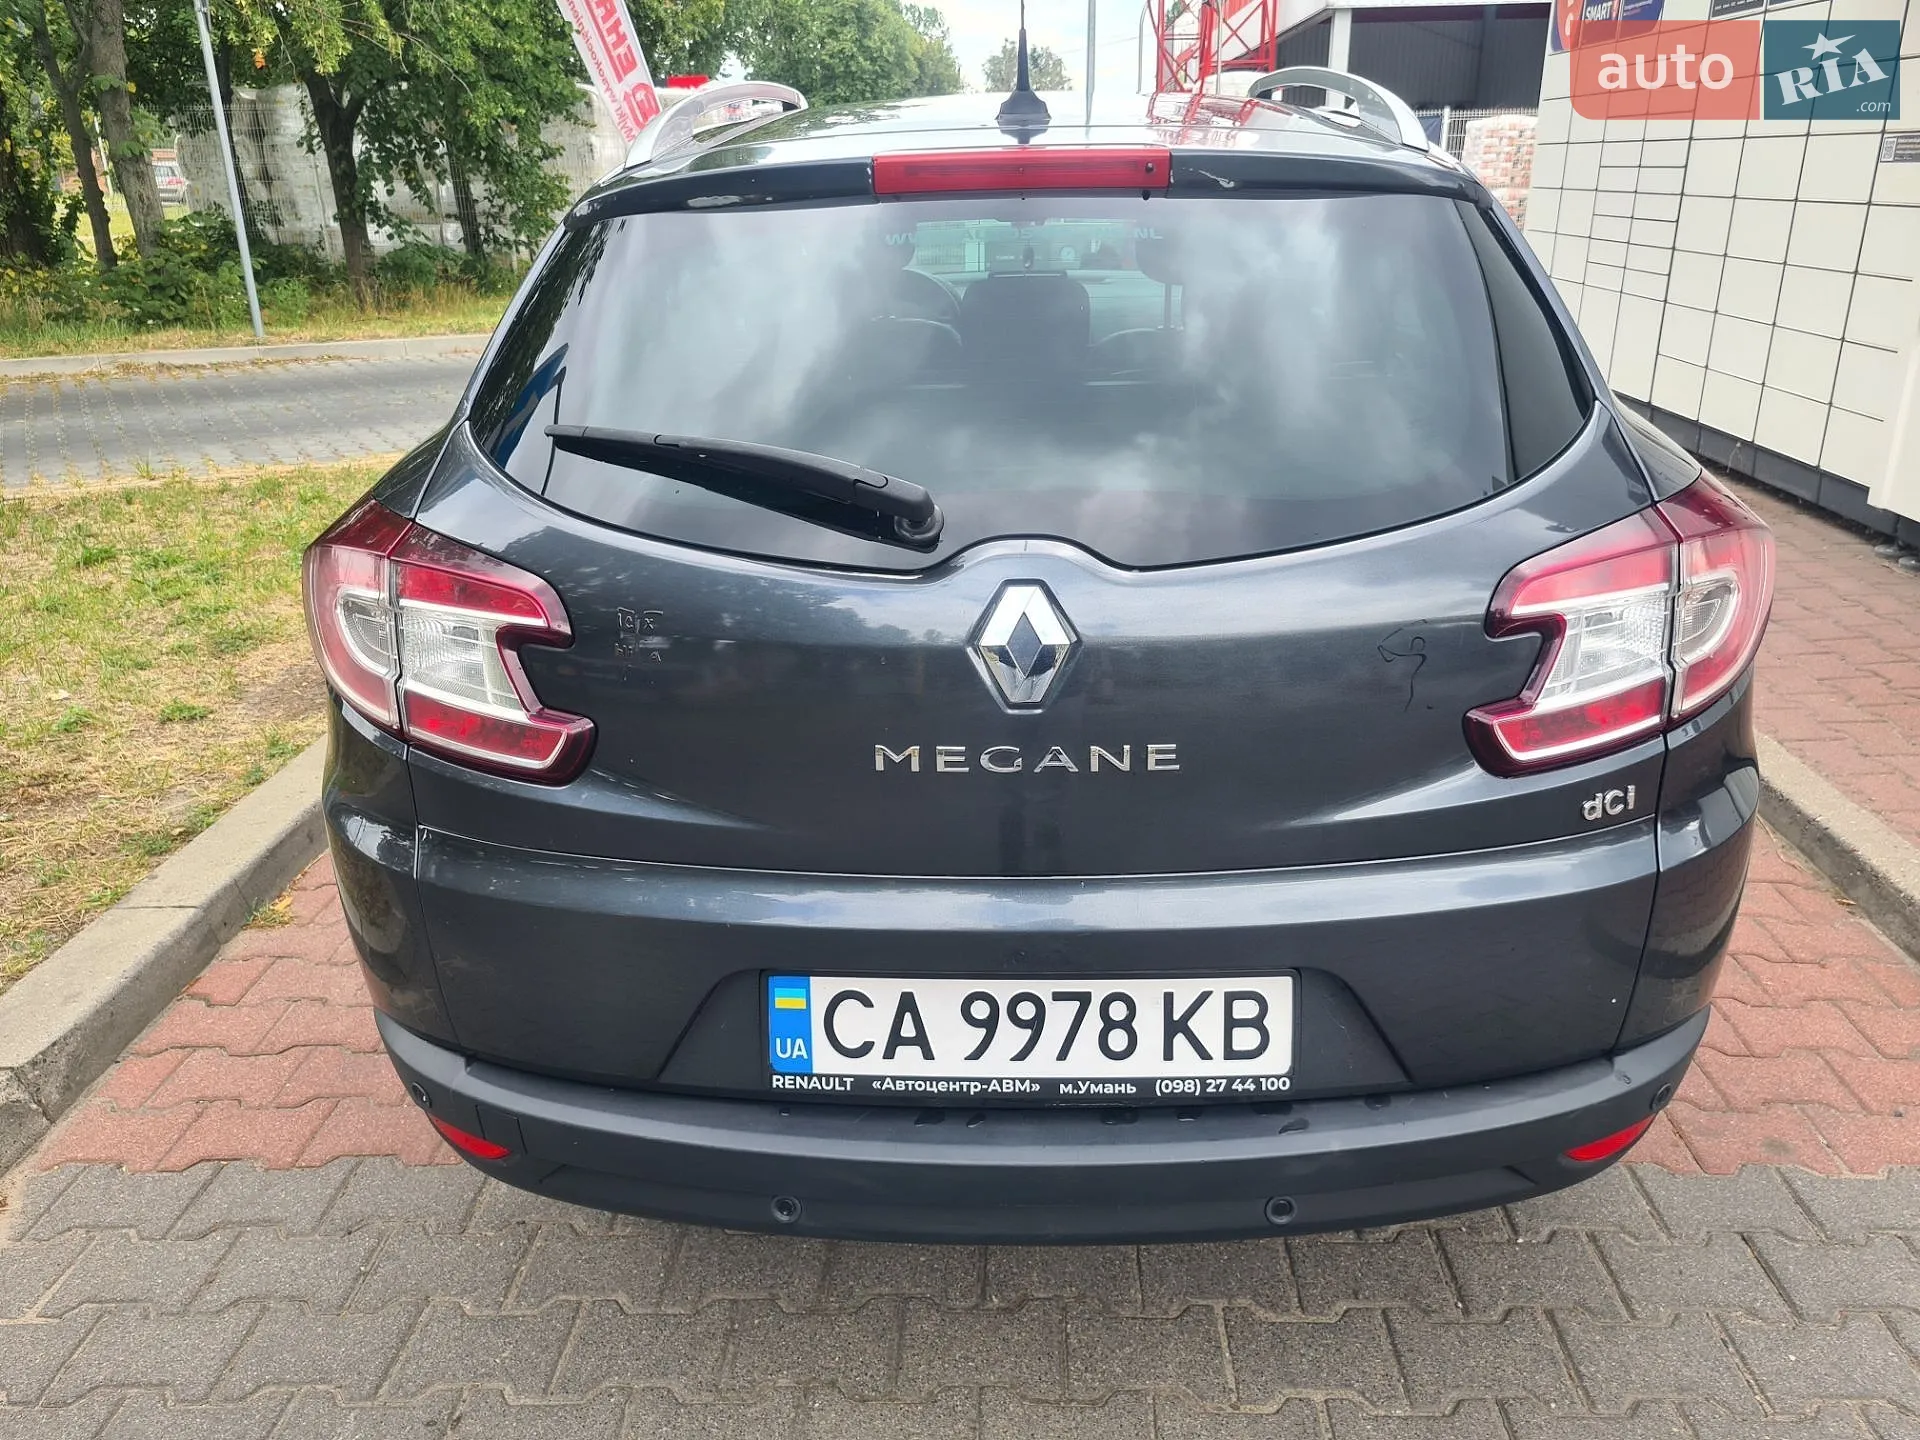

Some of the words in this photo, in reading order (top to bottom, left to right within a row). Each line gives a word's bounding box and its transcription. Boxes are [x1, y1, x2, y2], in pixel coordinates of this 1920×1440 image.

[875, 744, 1180, 773] MEGANE
[823, 989, 935, 1061] CA
[960, 991, 1138, 1061] 9978
[1163, 990, 1271, 1061] KB
[775, 1038, 809, 1060] UA
[772, 1075, 854, 1091] RENAULT
[872, 1077, 1041, 1095] «Автоцентр-АВМ»
[1059, 1080, 1137, 1095] м.Умань
[1155, 1079, 1201, 1096] (098)
[1206, 1078, 1227, 1093] 27
[1231, 1079, 1257, 1092] 44
[1260, 1077, 1290, 1091] 100
